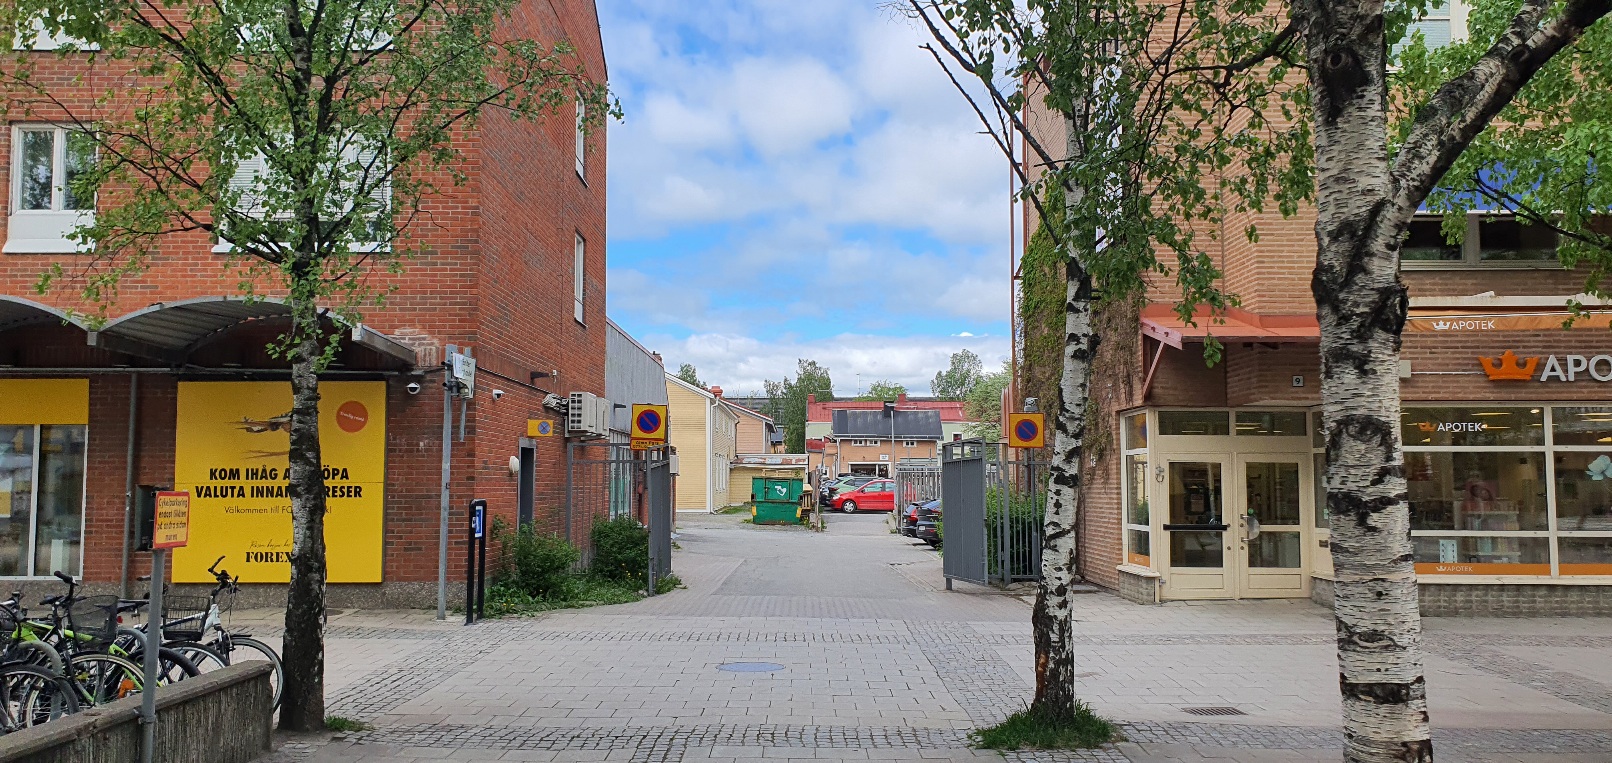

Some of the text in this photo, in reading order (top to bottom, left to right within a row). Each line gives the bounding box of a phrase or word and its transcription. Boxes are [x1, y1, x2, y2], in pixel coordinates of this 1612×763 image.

[1451, 320, 1495, 330] APOTEK
[1294, 377, 1301, 385] 9
[1437, 422, 1483, 432] APOTEK
[209, 467, 240, 481] KOM
[245, 465, 279, 481] IHÅG
[322, 464, 350, 480] ÖPA
[195, 485, 246, 498] VALUTA
[224, 505, 268, 514] Välkommen
[270, 505, 280, 514] till
[245, 551, 292, 563] FOREX
